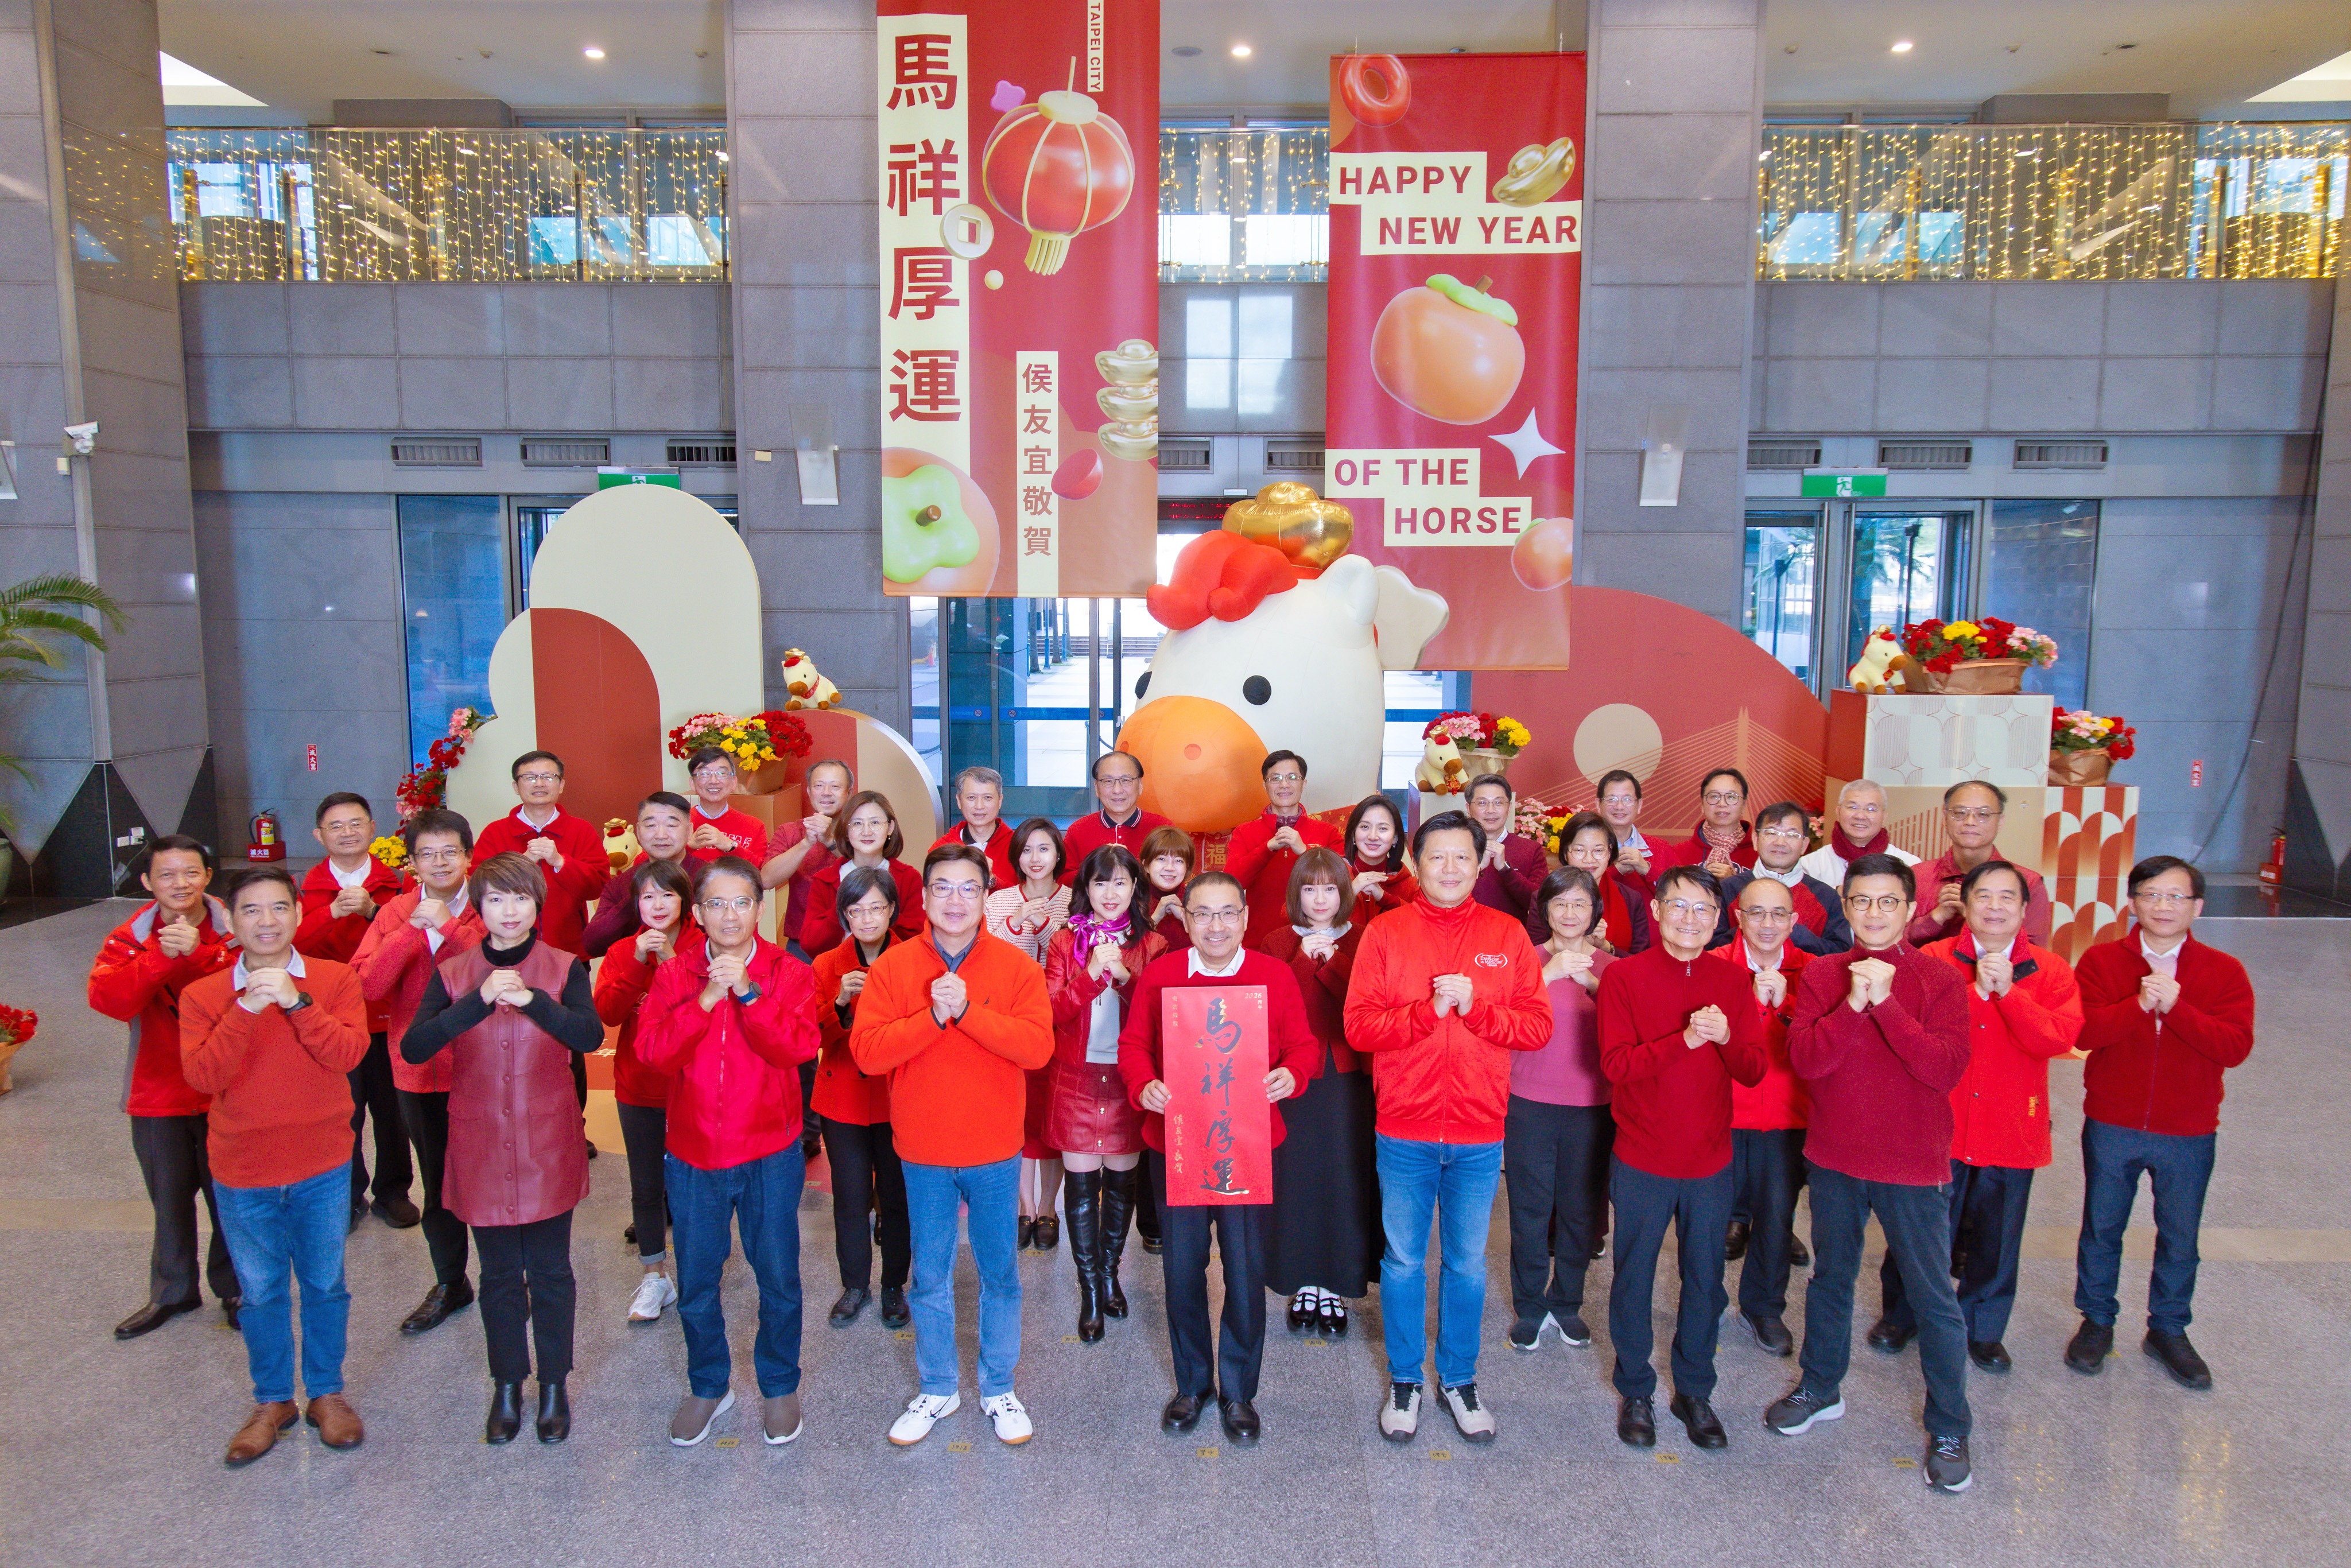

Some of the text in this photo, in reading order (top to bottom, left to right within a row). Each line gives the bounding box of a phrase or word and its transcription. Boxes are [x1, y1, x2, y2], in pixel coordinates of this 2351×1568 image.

[1091, 2, 1100, 91] TAIPEI CITY
[1340, 165, 1472, 195] HAPPY
[886, 34, 961, 421] 馬祥厚運
[1379, 215, 1577, 245] NEW YEAR
[1022, 363, 1053, 556] 侯友宜敬賀
[1334, 459, 1469, 486] OF THE
[1395, 506, 1521, 534] HORSE
[1206, 844, 1226, 865] 福
[1194, 997, 1250, 1196] 馬祥厚運
